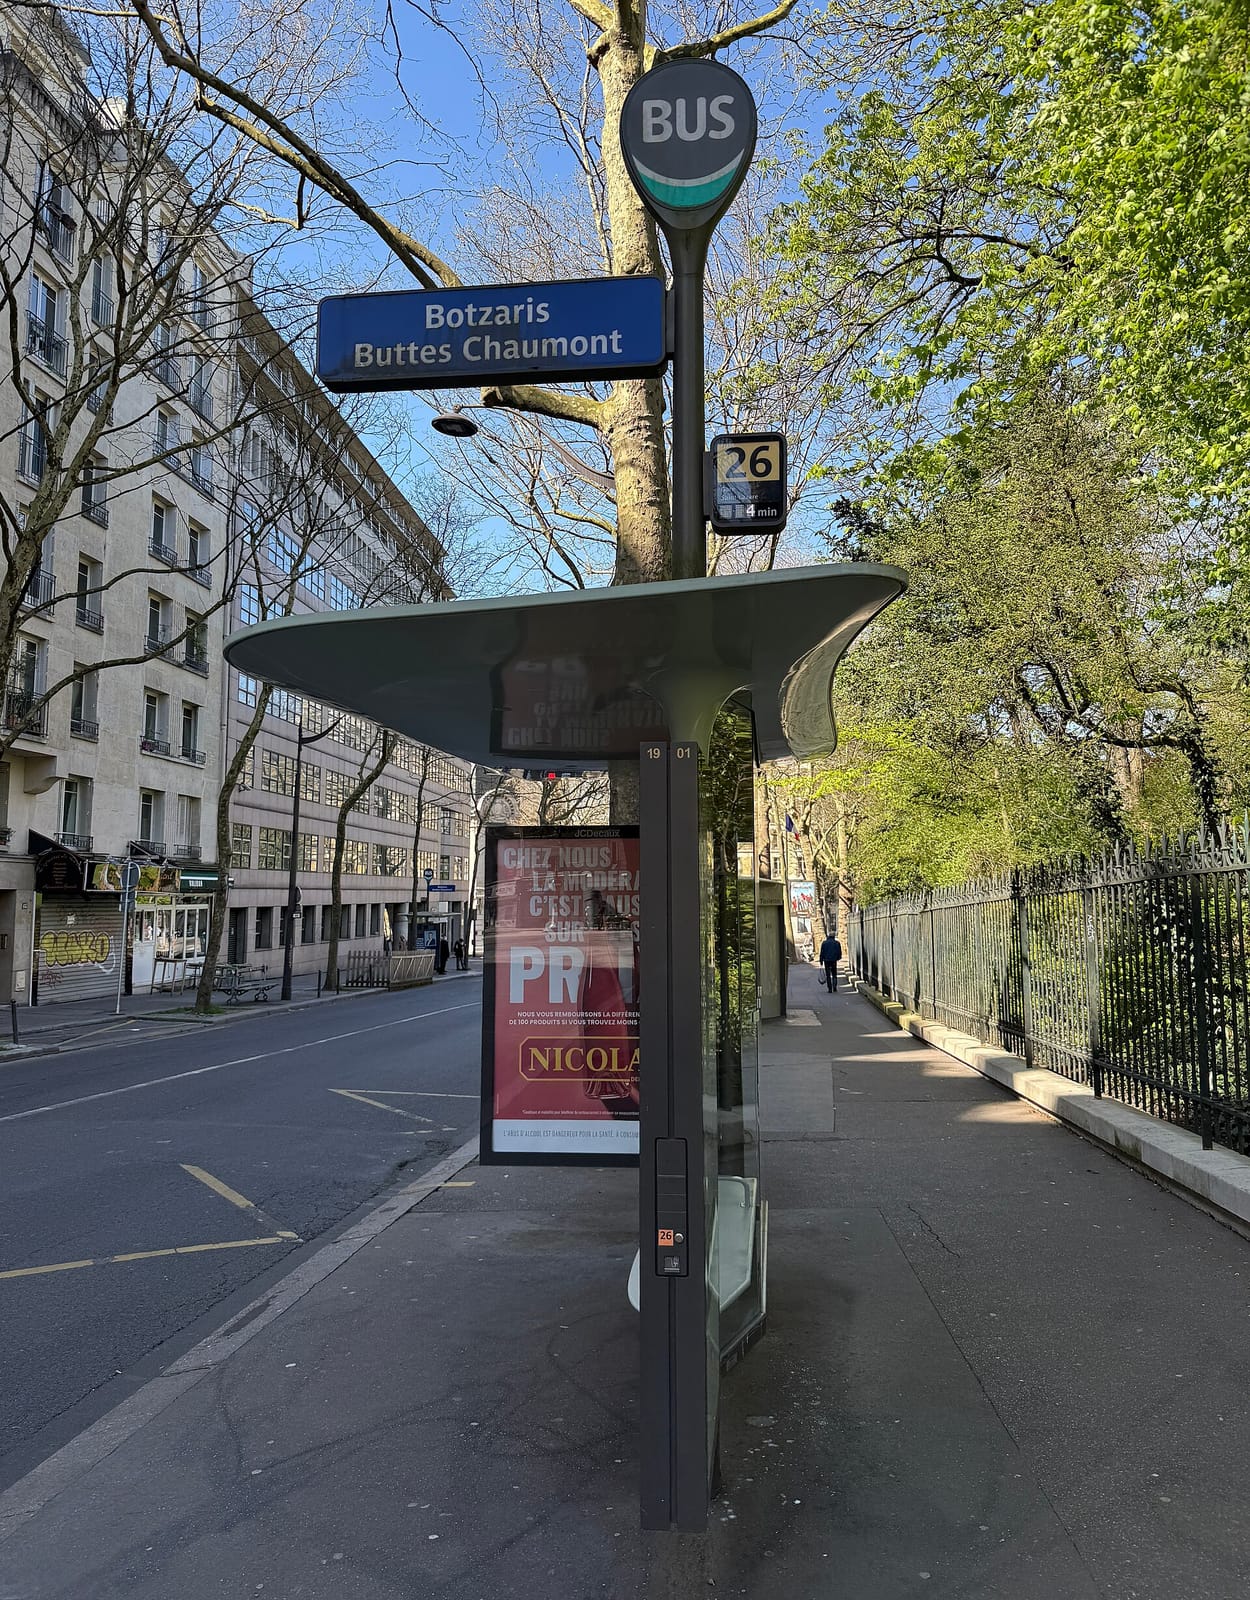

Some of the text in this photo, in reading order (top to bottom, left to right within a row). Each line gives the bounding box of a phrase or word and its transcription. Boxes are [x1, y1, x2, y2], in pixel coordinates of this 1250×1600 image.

[642, 94, 735, 144] BUS
[424, 296, 550, 330] Botzaris
[353, 328, 623, 368] Buttes Chaumont
[724, 445, 773, 479] 26
[746, 504, 777, 517] 4 min
[647, 747, 660, 759] 19
[676, 747, 691, 759] 01
[574, 829, 621, 838] JCDecaux
[503, 846, 617, 869] CHEZ NOUS,
[531, 870, 557, 892] LA
[529, 895, 582, 917] C'EST
[544, 920, 585, 943] SUR
[660, 1230, 672, 1240] 26
